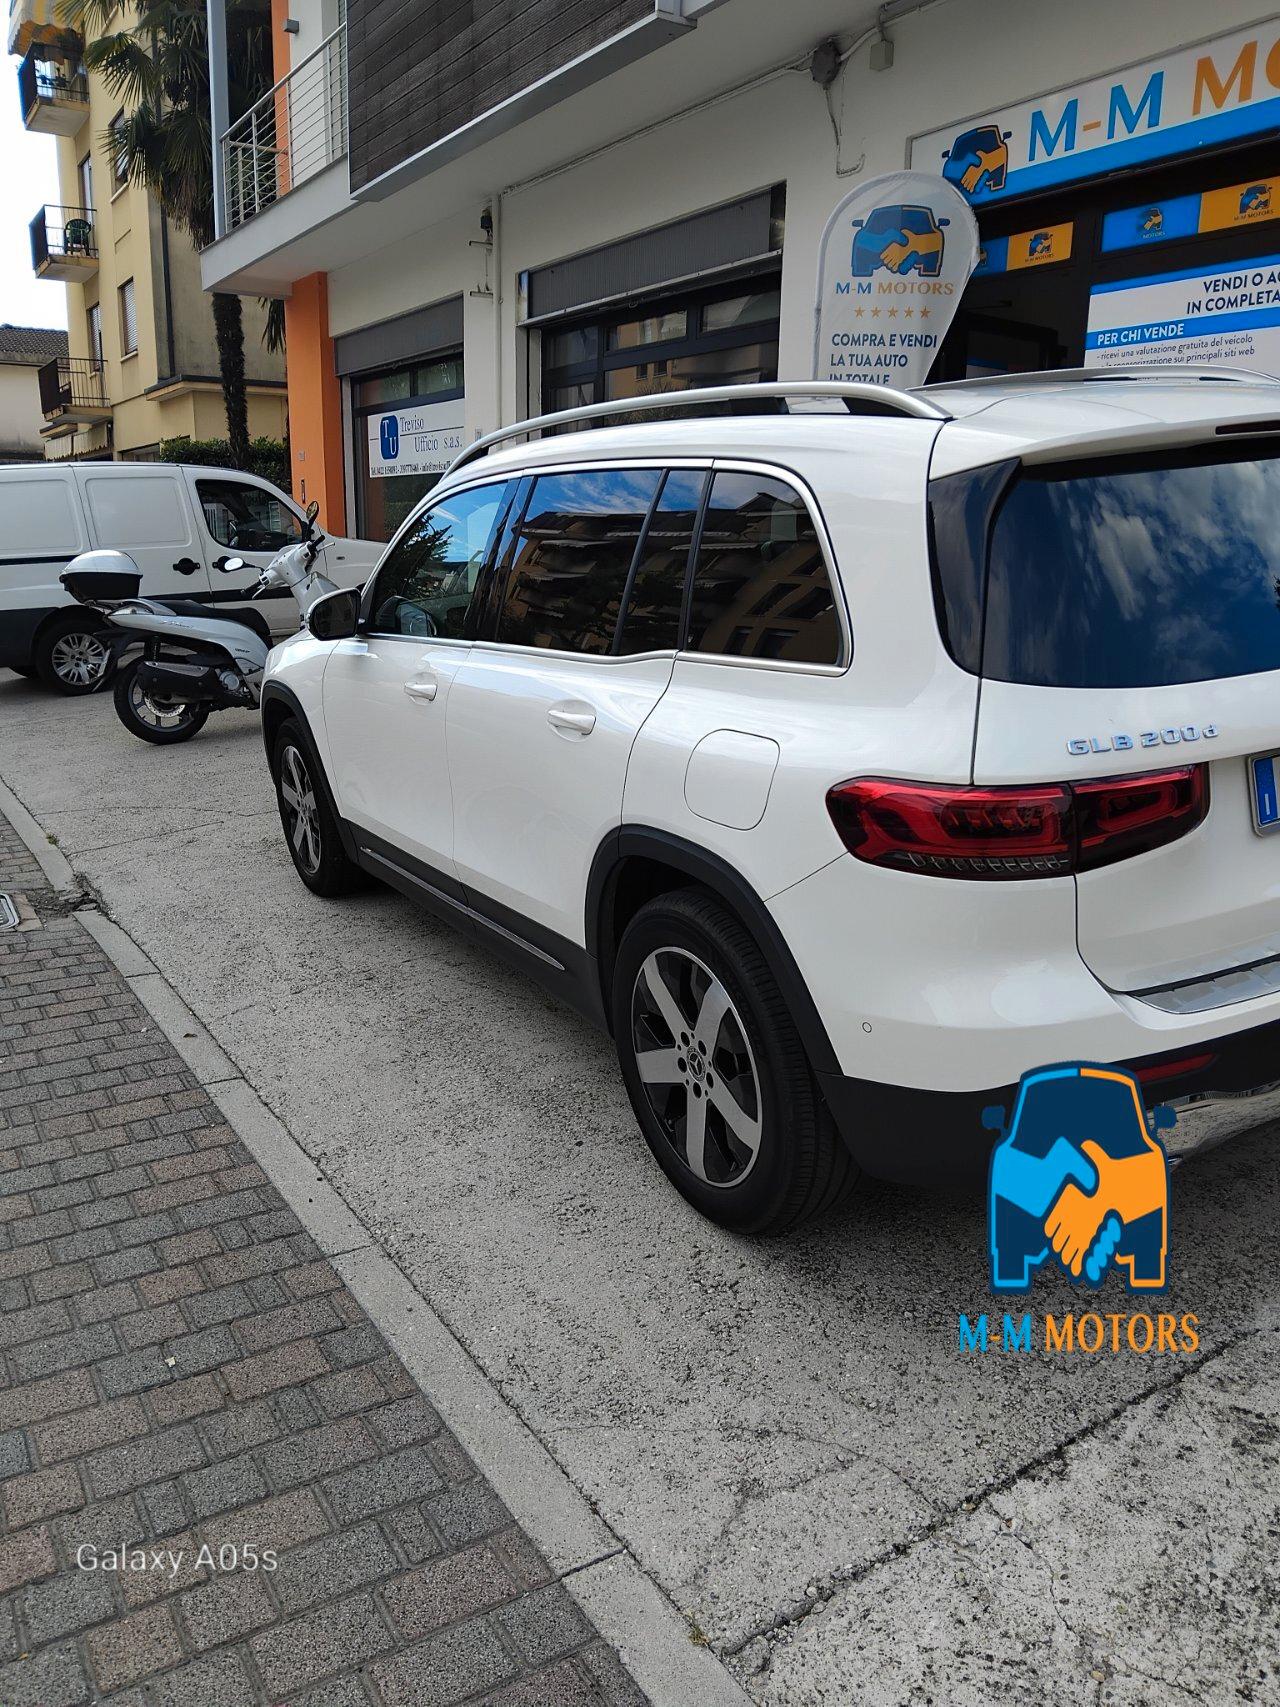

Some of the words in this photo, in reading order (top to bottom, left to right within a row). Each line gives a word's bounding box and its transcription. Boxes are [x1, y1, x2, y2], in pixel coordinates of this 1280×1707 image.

[1029, 71, 1164, 162] M-M
[1192, 37, 1280, 116] M
[836, 282, 872, 294] M-M
[878, 282, 954, 295] MOTORS
[1203, 274, 1248, 293] VENDI
[1252, 272, 1263, 287] O
[1186, 299, 1202, 314] IN
[831, 333, 886, 347] COMPRA
[889, 333, 897, 347] E
[899, 334, 938, 348] VENDI
[1097, 332, 1118, 346] PER
[1120, 328, 1141, 343] CHI
[1144, 322, 1185, 339] VENDE
[1101, 349, 1119, 360] ricevi
[1121, 350, 1134, 358] una
[1136, 343, 1176, 356] valutazione
[1178, 340, 1209, 354] gratuita
[1211, 336, 1223, 347] del
[1224, 333, 1253, 345] veicolo
[1174, 353, 1185, 363] sui
[1186, 348, 1222, 363] principali
[1224, 347, 1237, 358] siti
[1238, 345, 1255, 356] web
[830, 354, 845, 367] LA
[849, 354, 872, 367] TUA
[875, 354, 908, 367] AUTO
[382, 419, 390, 438] T
[400, 415, 424, 432] Treviso
[389, 437, 397, 455] U
[414, 435, 438, 452] Ufficio
[443, 436, 462, 449] s.a.s.
[1067, 735, 1133, 755] GLB
